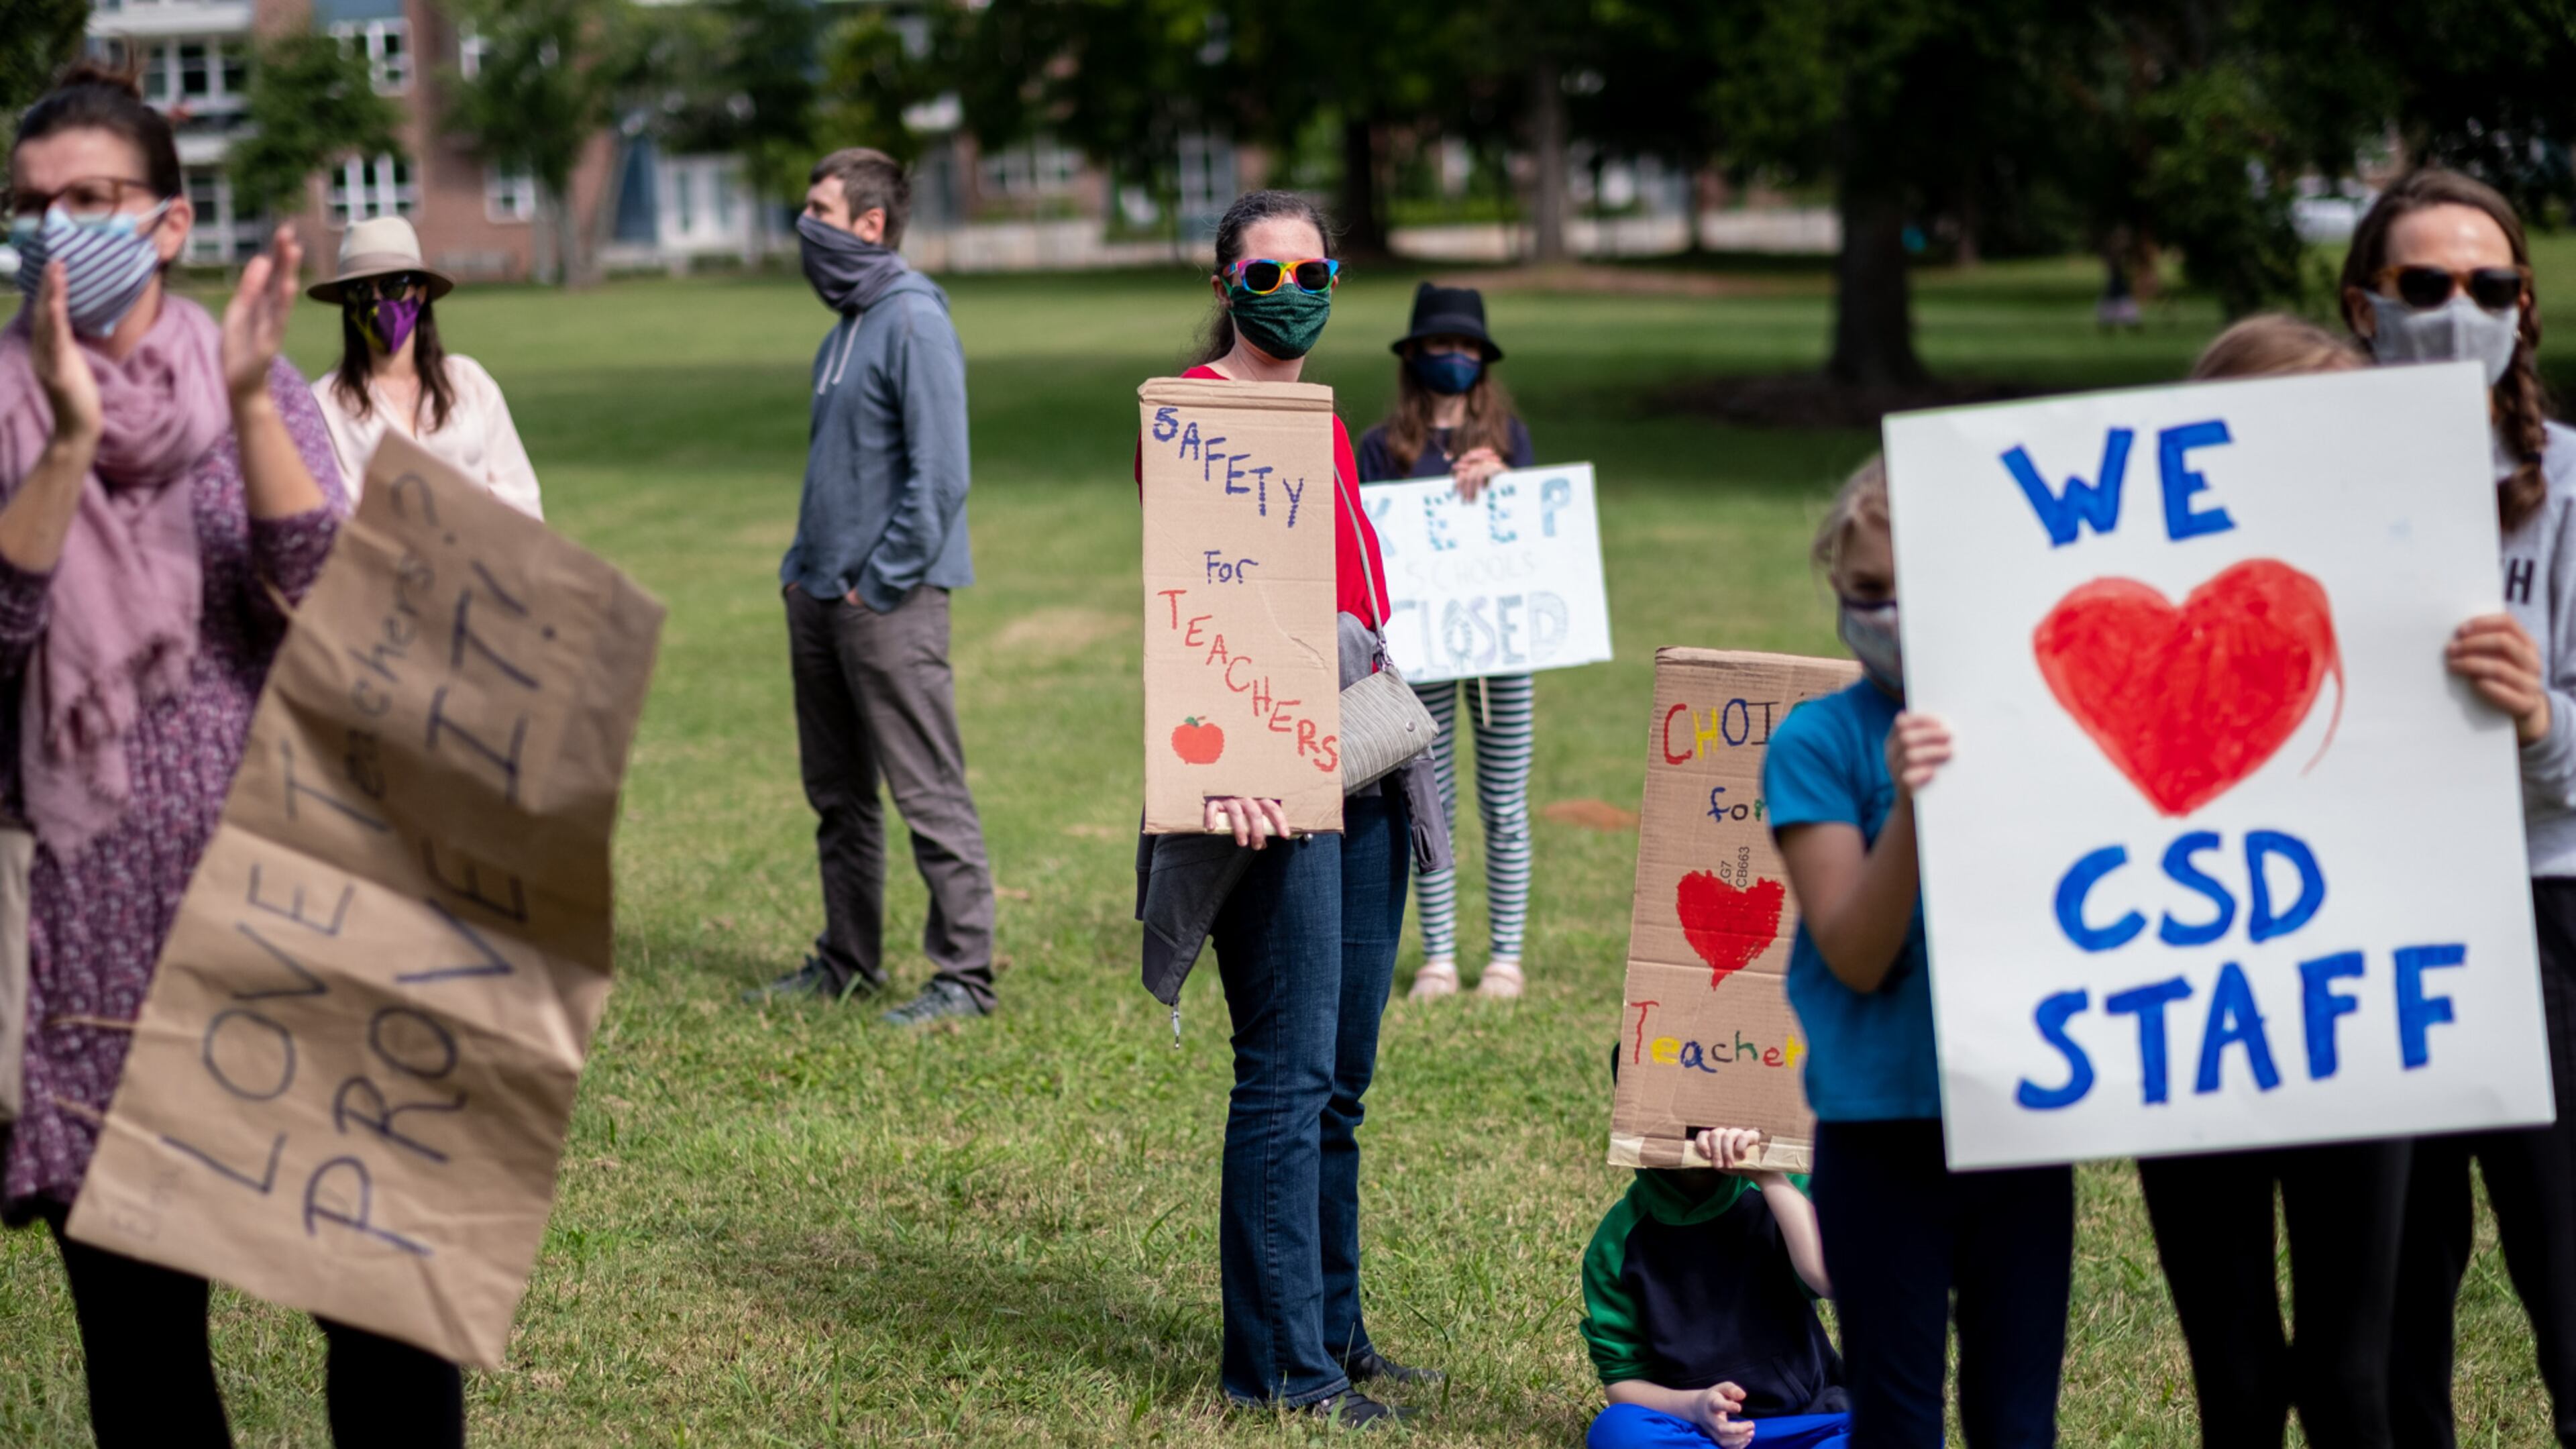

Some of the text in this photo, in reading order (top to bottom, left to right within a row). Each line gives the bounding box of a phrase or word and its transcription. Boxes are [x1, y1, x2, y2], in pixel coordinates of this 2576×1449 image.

[1152, 407, 1304, 529] SAFETY
[2000, 418, 2237, 547] WE
[1157, 590, 1339, 772] TEACHERS
[1664, 698, 1809, 765] CHOI
[303, 559, 556, 1256] PROVE IT!
[1735, 846, 1750, 888] CB663
[2053, 828, 2325, 953] CSD
[158, 863, 354, 1194] LOVE
[2015, 942, 2468, 1111] STAFF
